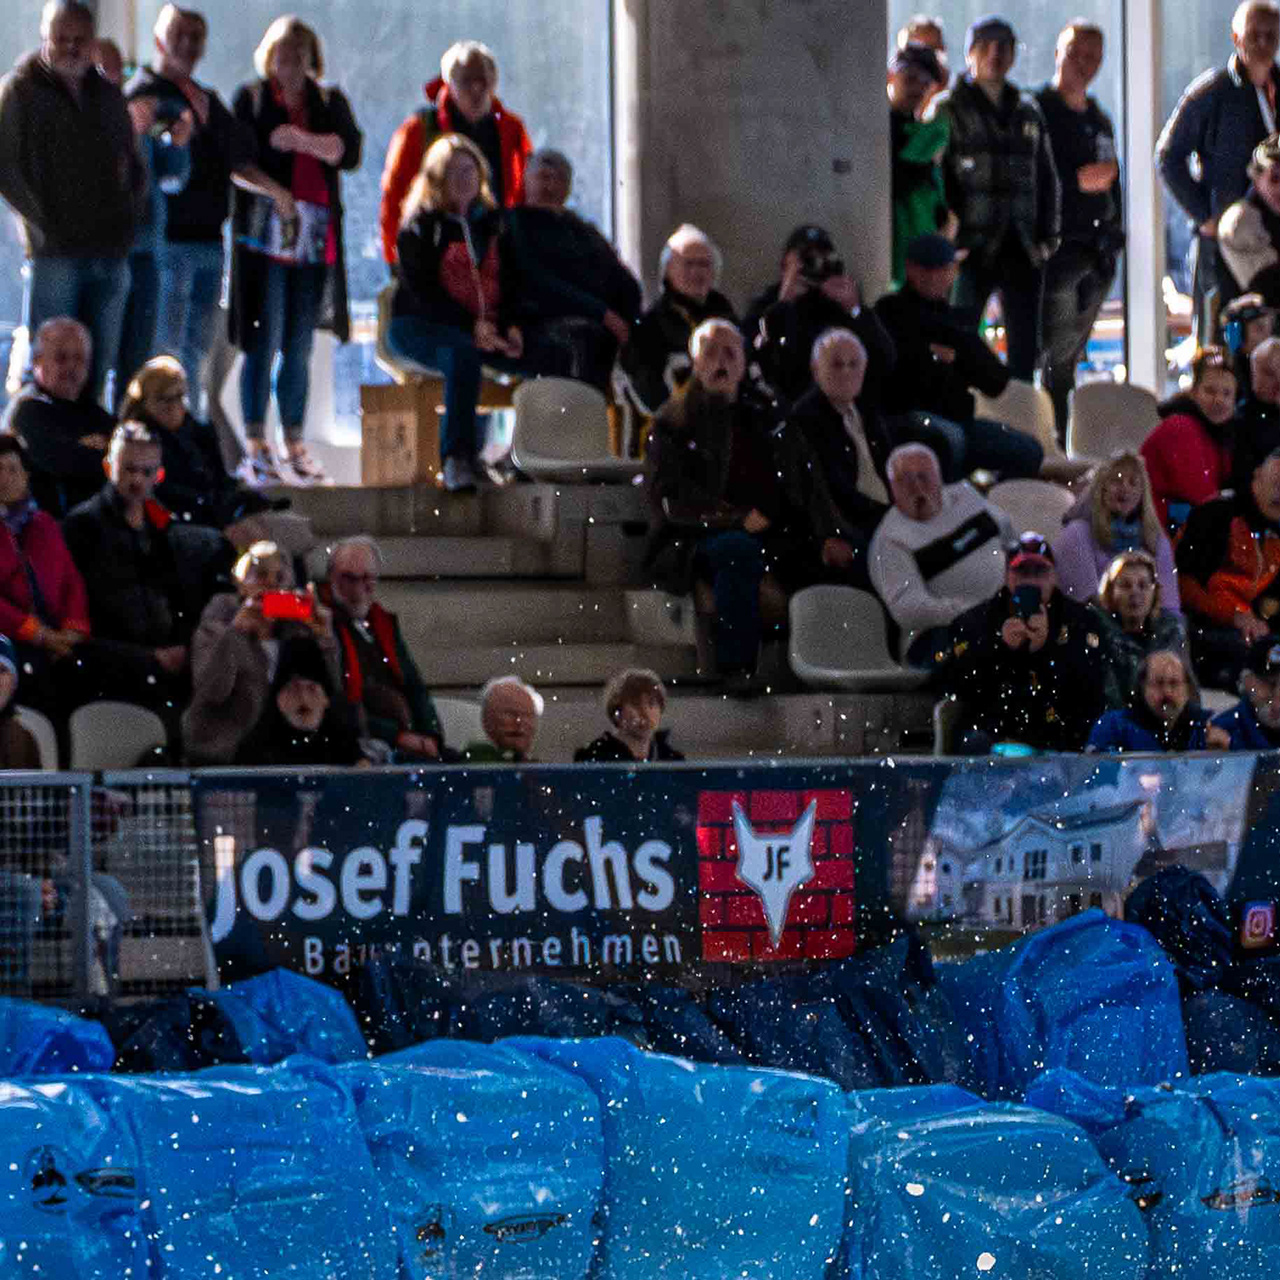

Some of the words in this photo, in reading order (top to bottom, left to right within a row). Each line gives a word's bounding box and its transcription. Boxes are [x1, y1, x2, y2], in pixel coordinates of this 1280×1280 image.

[211, 818, 429, 945] Josef
[444, 814, 676, 914] Fuchs
[762, 844, 791, 882] JF
